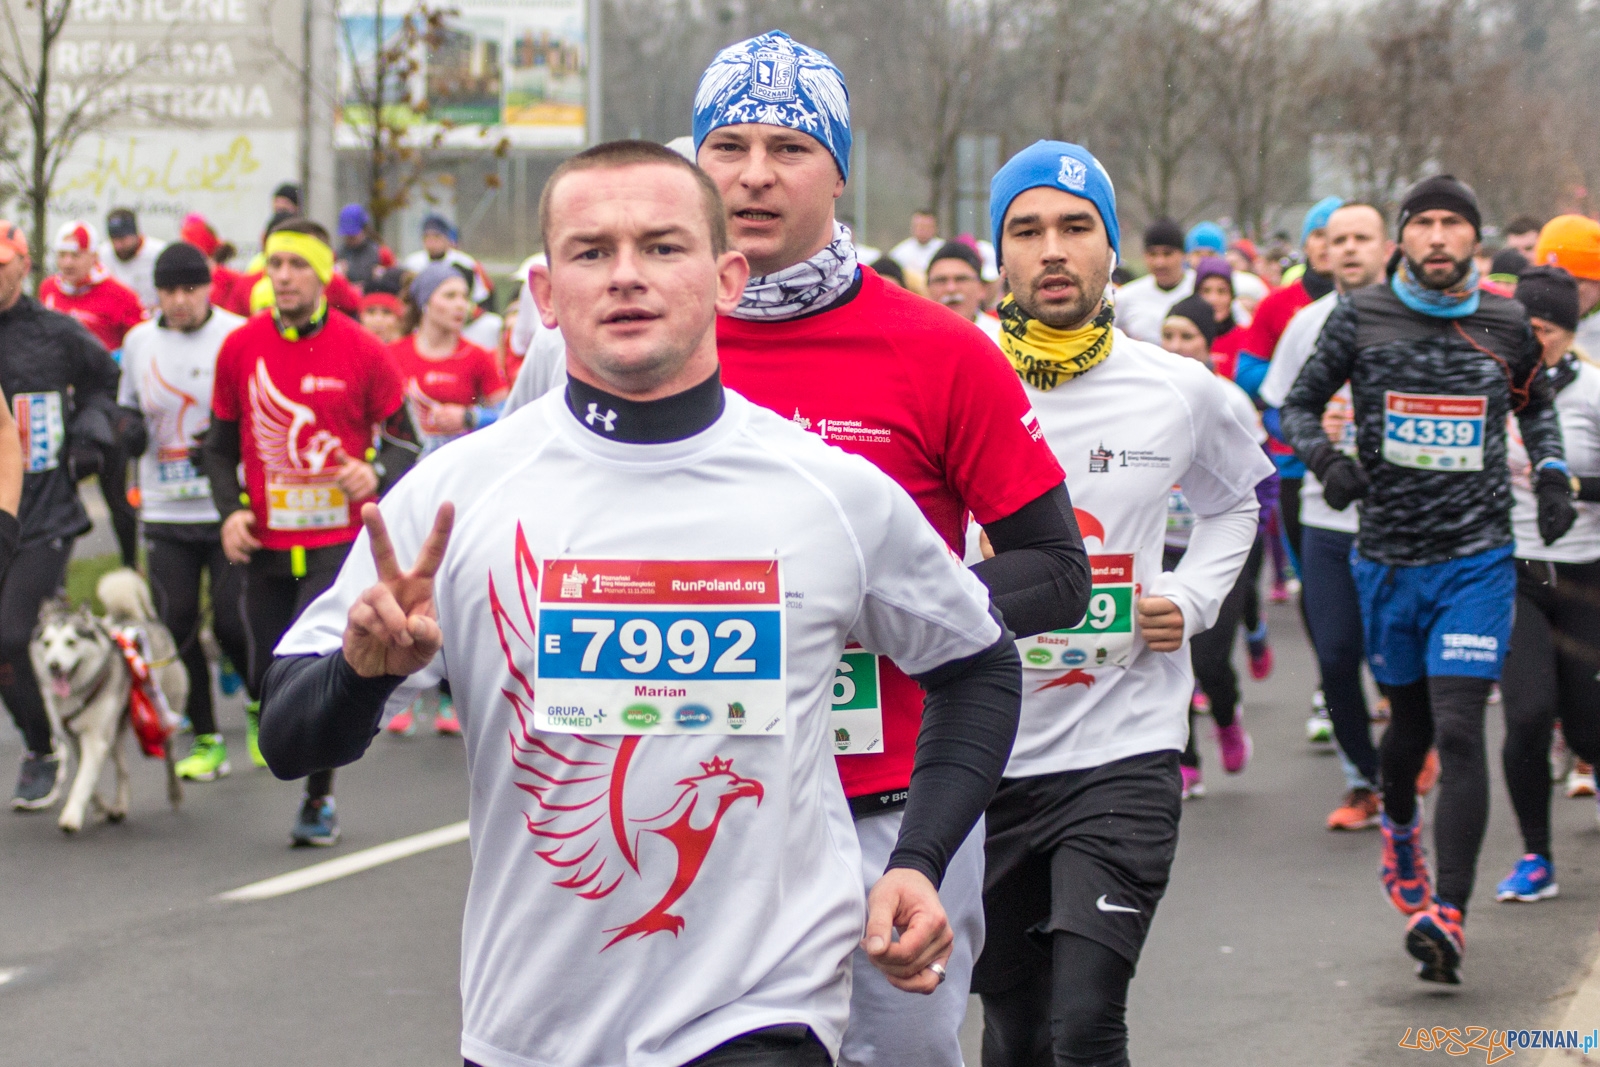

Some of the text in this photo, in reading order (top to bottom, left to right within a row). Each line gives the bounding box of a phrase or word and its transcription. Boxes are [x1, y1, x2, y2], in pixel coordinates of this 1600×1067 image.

[1396, 419, 1475, 446] 4339
[671, 579, 766, 593] RunPoland.org
[545, 618, 757, 674] E 7992
[1442, 634, 1498, 650] TERMO
[634, 685, 687, 697] Marian
[548, 706, 585, 716] GRUPA
[547, 716, 592, 727] LUXMED
[627, 713, 657, 724] energy
